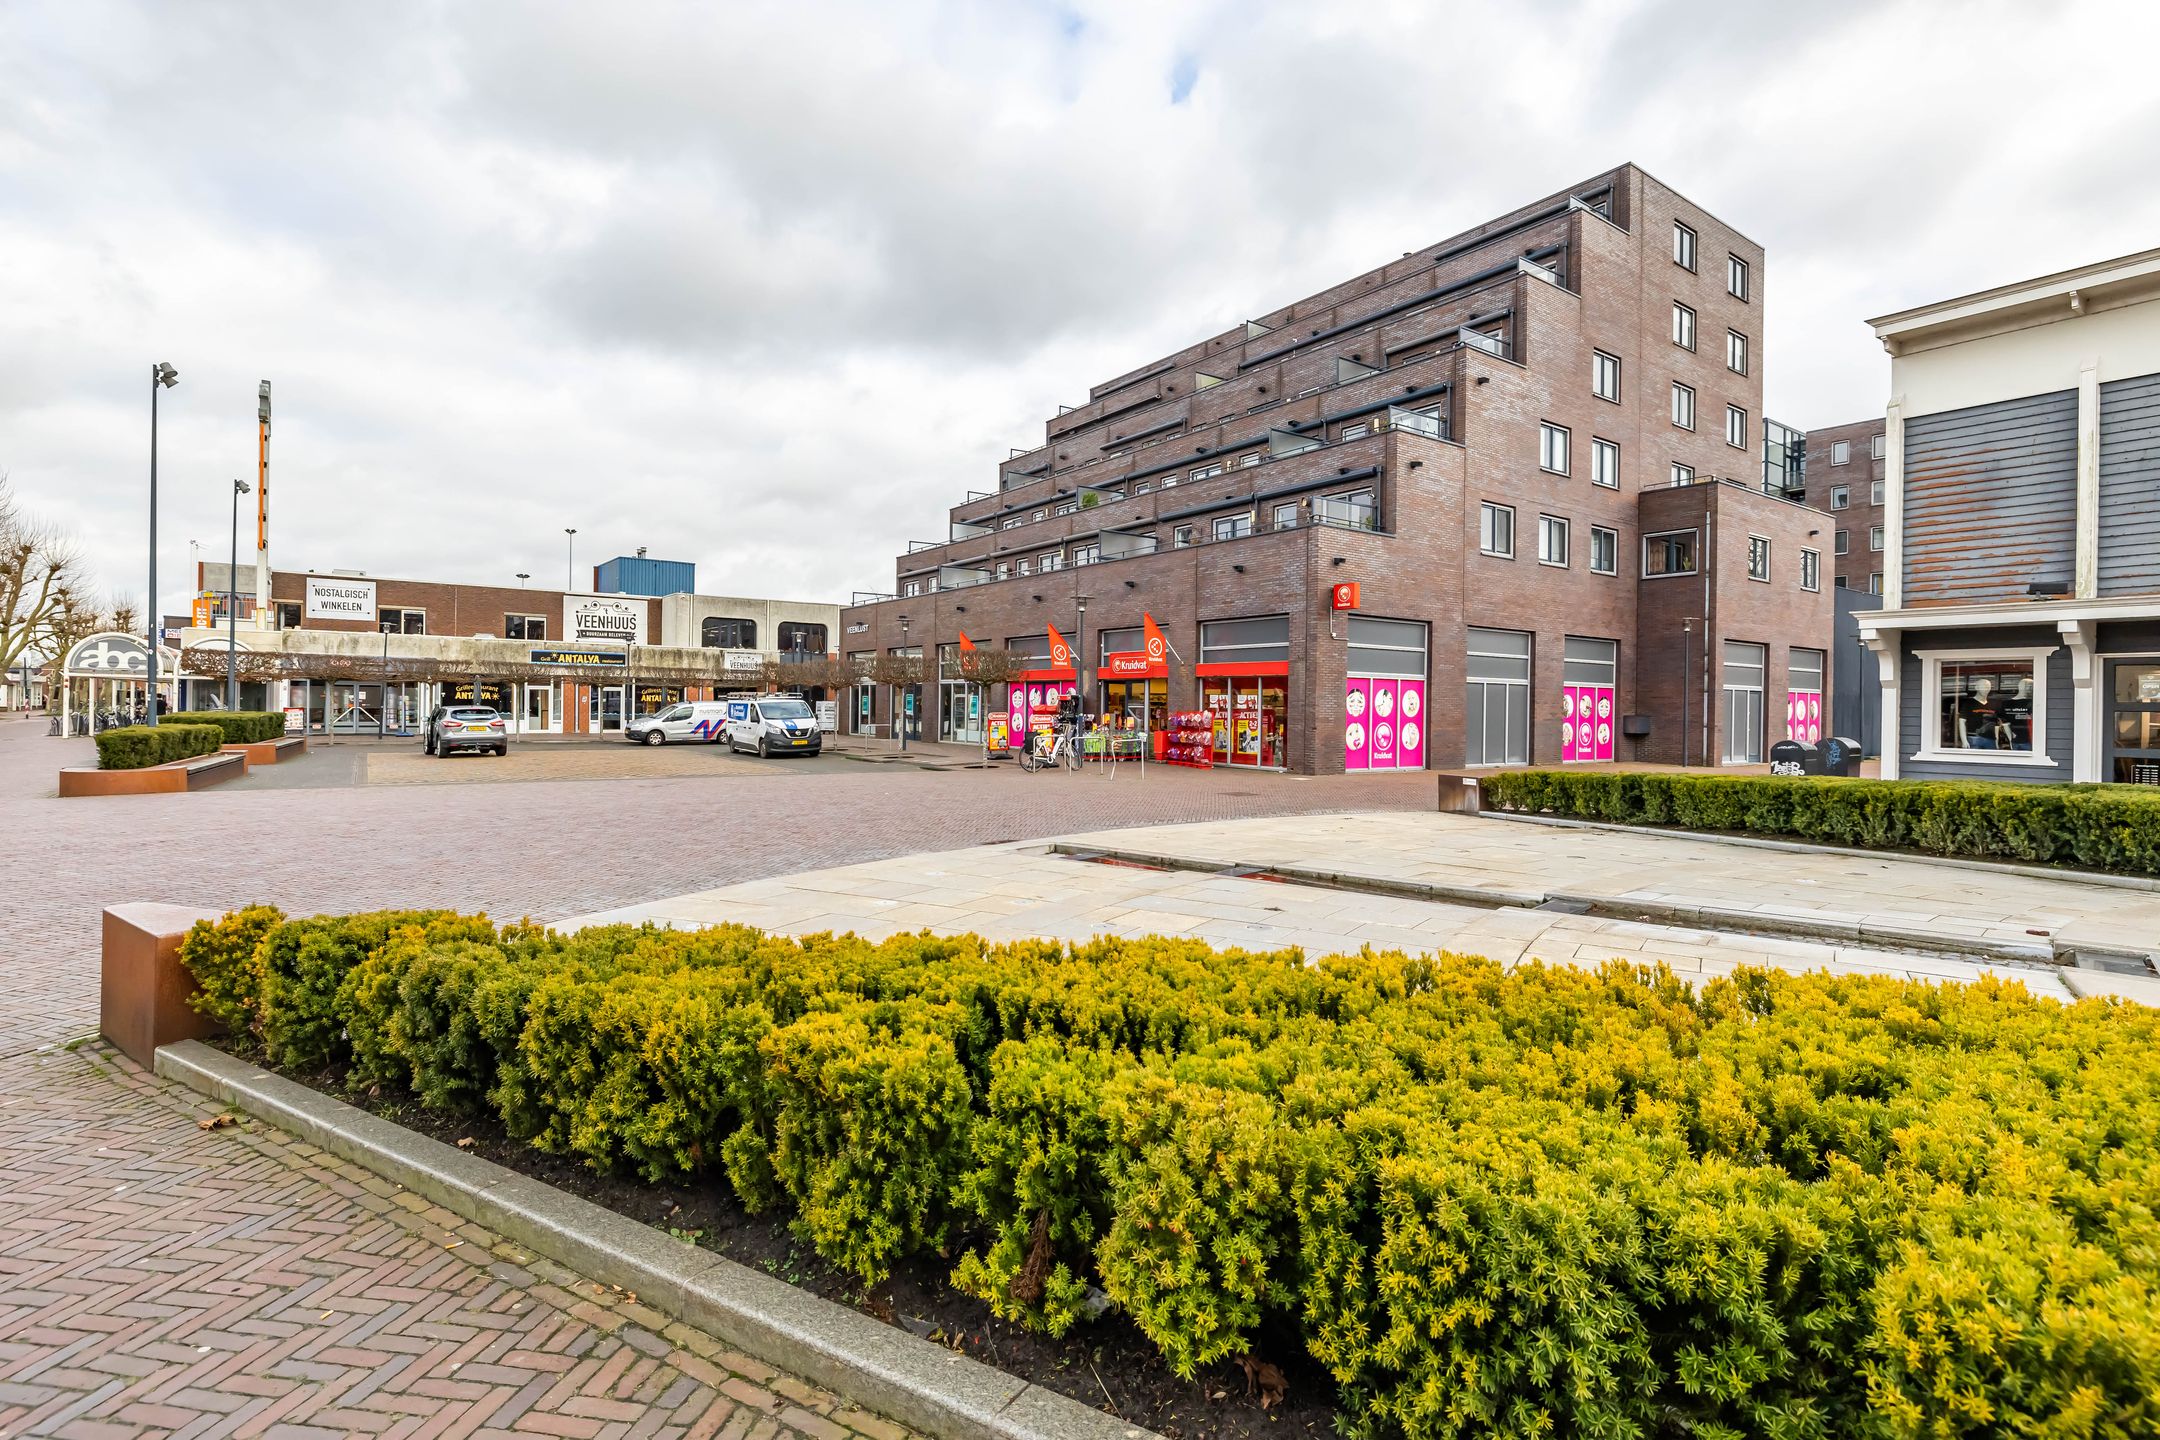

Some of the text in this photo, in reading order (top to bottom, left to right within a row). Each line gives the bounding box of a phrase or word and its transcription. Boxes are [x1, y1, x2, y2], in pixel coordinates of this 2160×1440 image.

[314, 588, 368, 599] NOSTALGISCH
[321, 601, 362, 611] WINKELEN
[576, 614, 637, 630] VEENHUUS
[80, 642, 148, 670] abc
[558, 654, 600, 664] ANTALYA
[1121, 659, 1147, 671] Kruidvat
